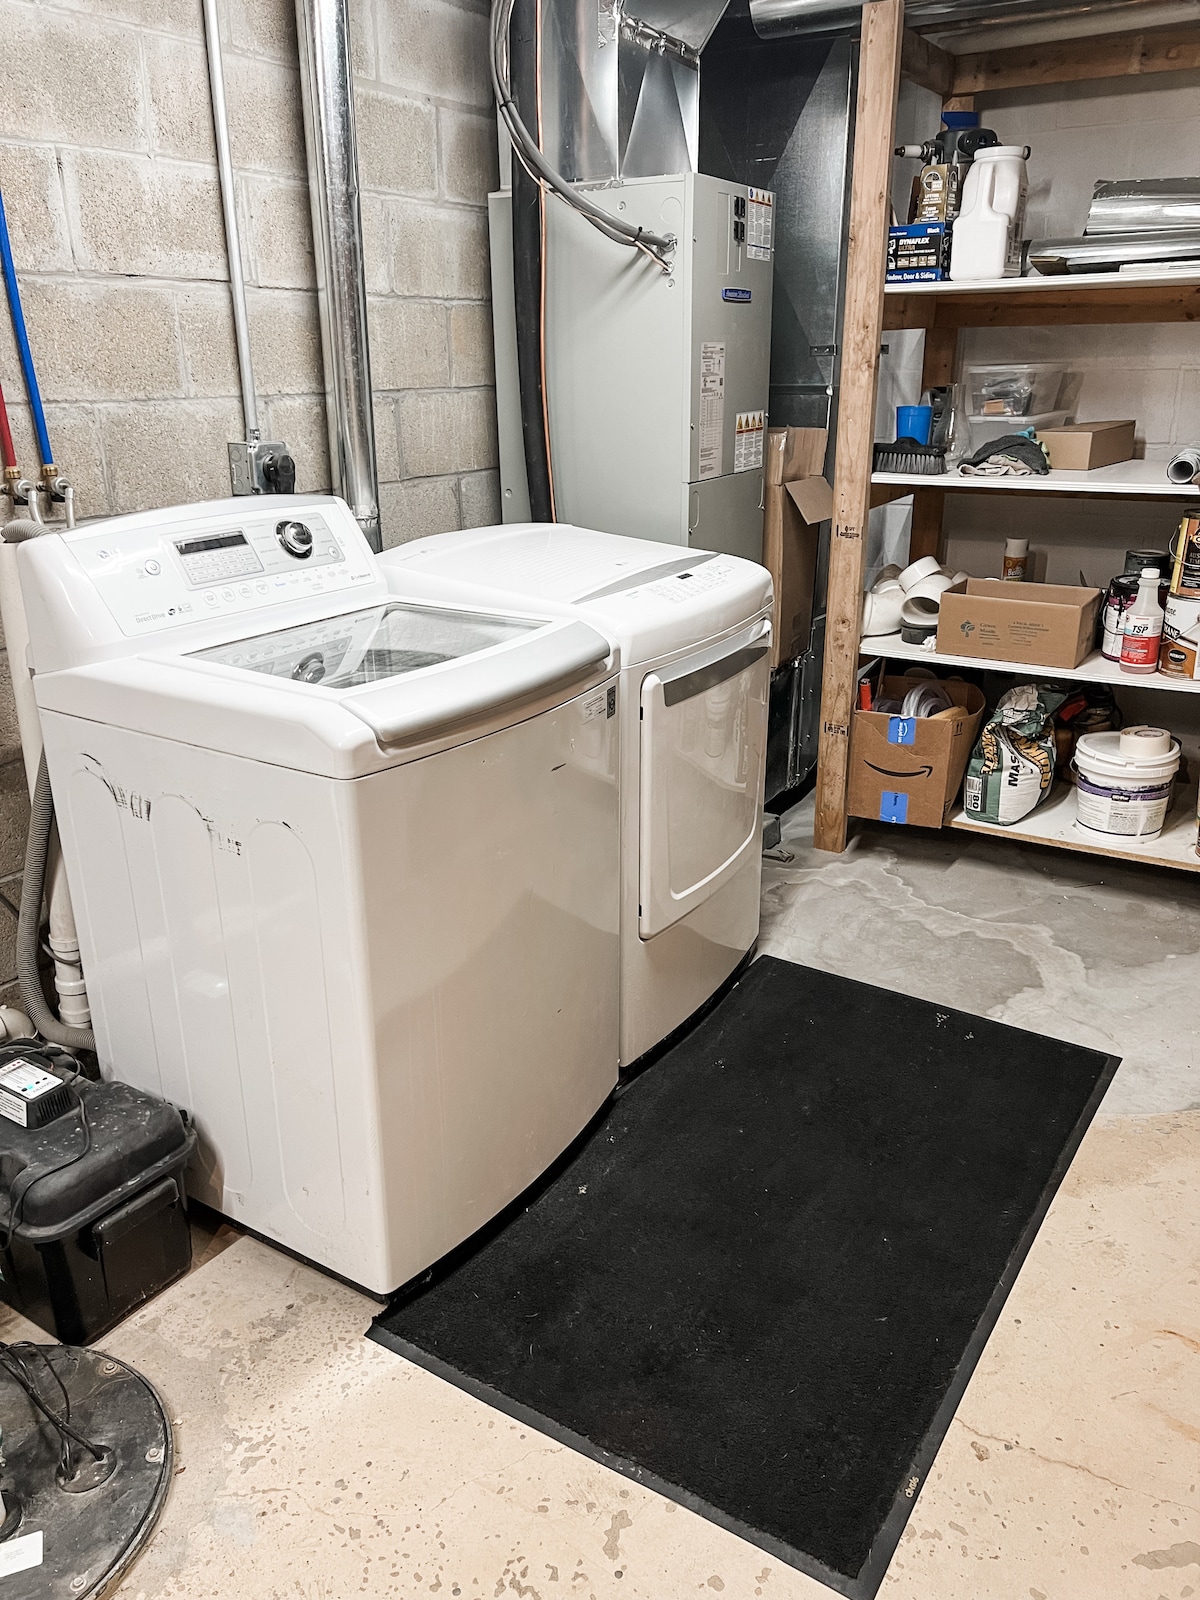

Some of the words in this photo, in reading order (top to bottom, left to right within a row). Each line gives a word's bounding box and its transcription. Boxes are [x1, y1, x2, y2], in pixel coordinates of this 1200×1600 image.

[899, 237, 930, 245] DYNAFLEX
[920, 272, 936, 280] Siding
[1132, 625, 1149, 634] TSP
[972, 794, 980, 809] 80
